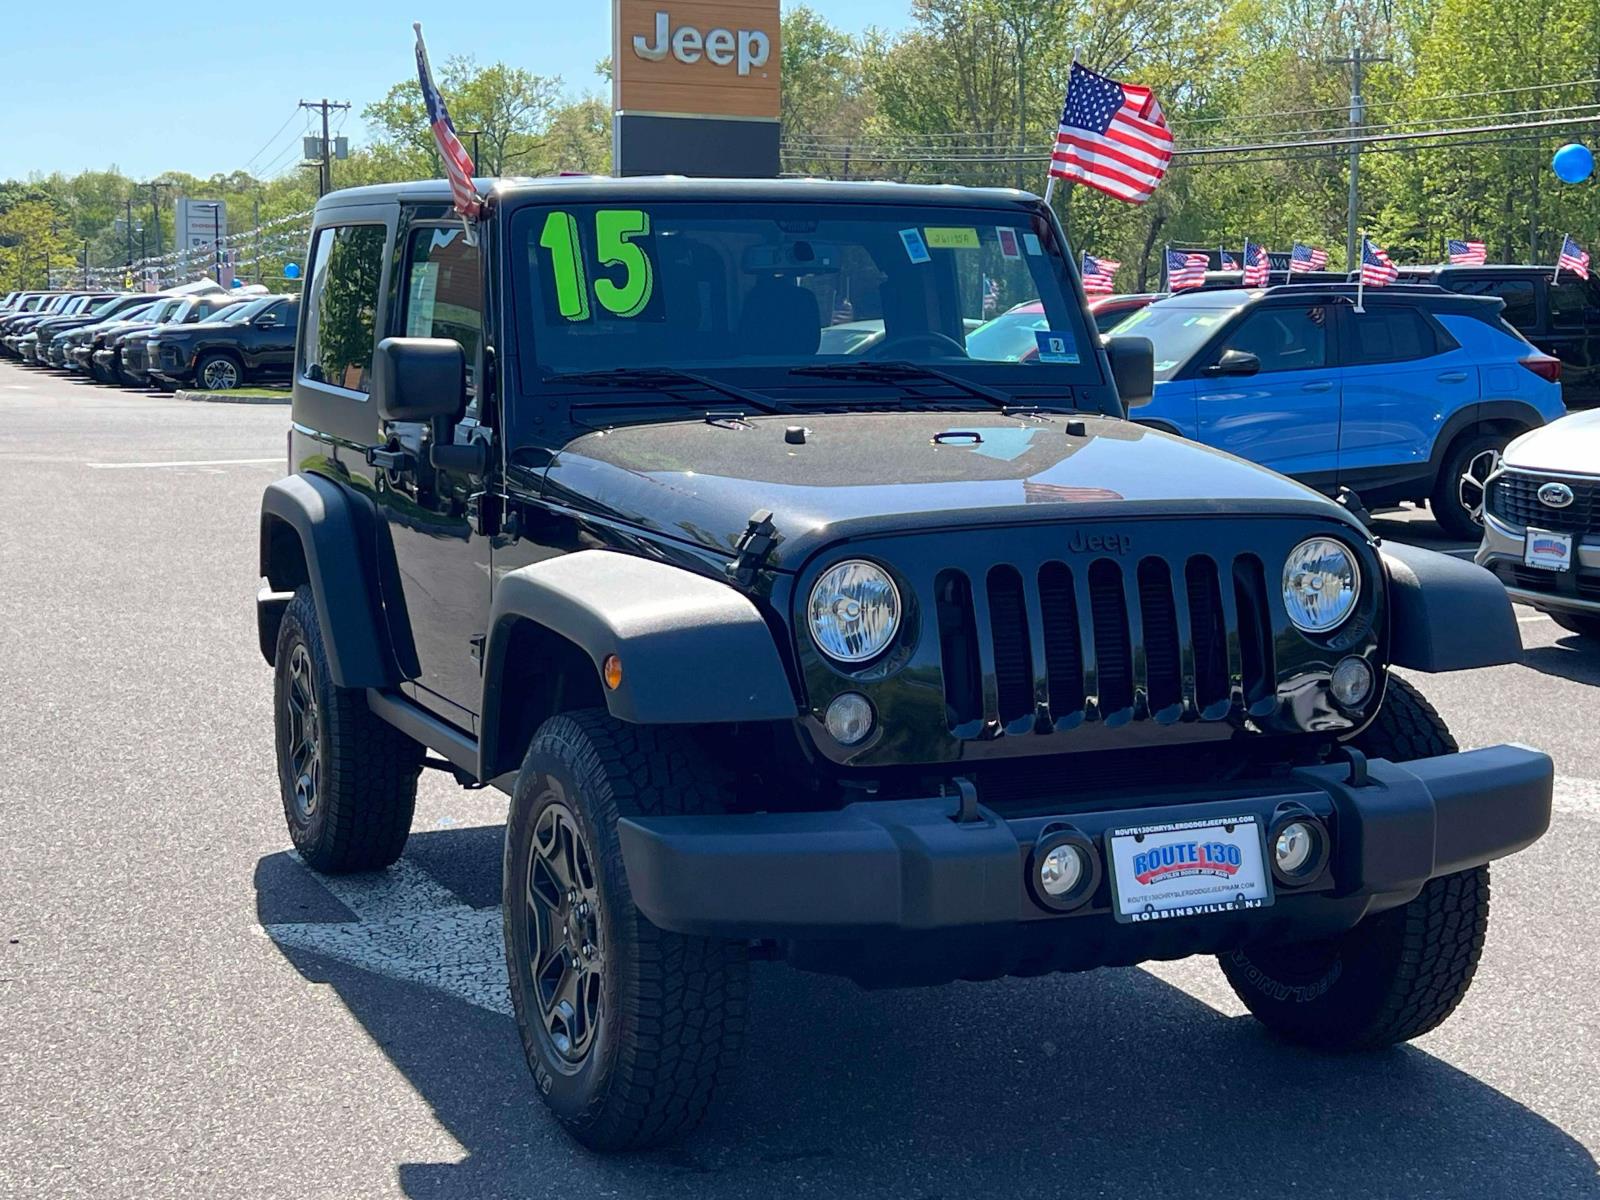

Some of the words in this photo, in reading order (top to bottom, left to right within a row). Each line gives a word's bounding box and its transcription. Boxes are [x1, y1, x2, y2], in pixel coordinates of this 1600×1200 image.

[632, 10, 770, 76] Jeep
[540, 209, 653, 321] 15
[1067, 528, 1132, 556] Jeep
[1133, 842, 1198, 877] ROUTE
[1199, 841, 1242, 866] 130
[1245, 899, 1263, 908] NJ
